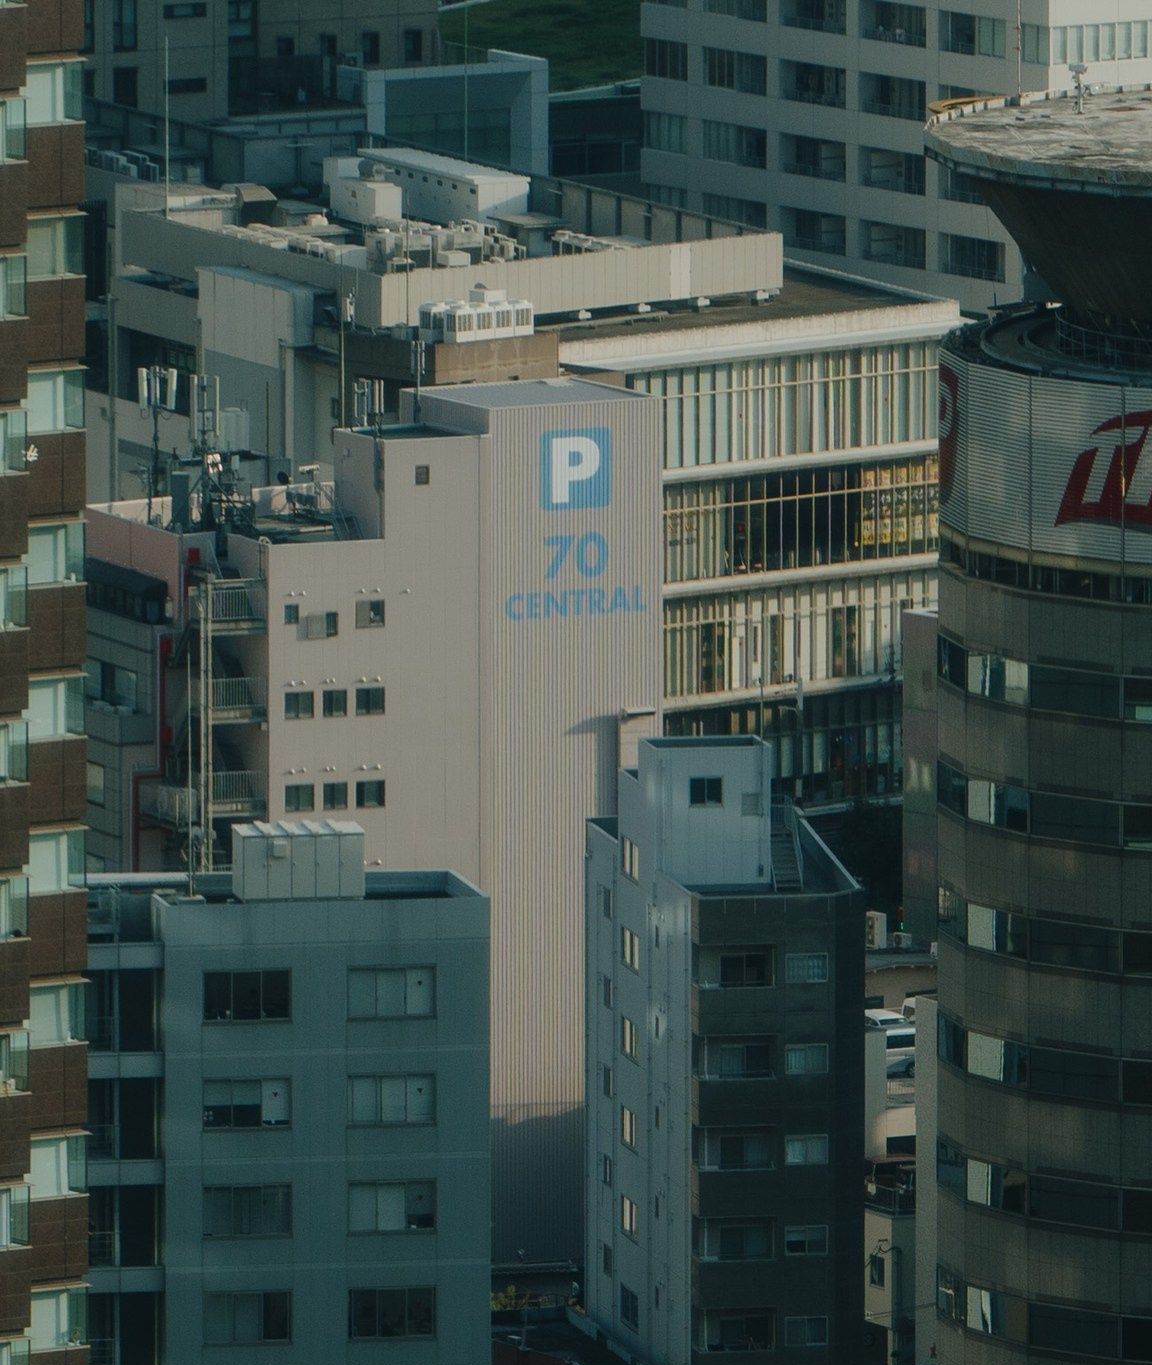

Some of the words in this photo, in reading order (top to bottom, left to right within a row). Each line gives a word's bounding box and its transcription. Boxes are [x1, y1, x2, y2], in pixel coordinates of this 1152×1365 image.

[551, 436, 601, 505] P
[543, 531, 609, 580] 70
[505, 585, 648, 622] CENTRAL
